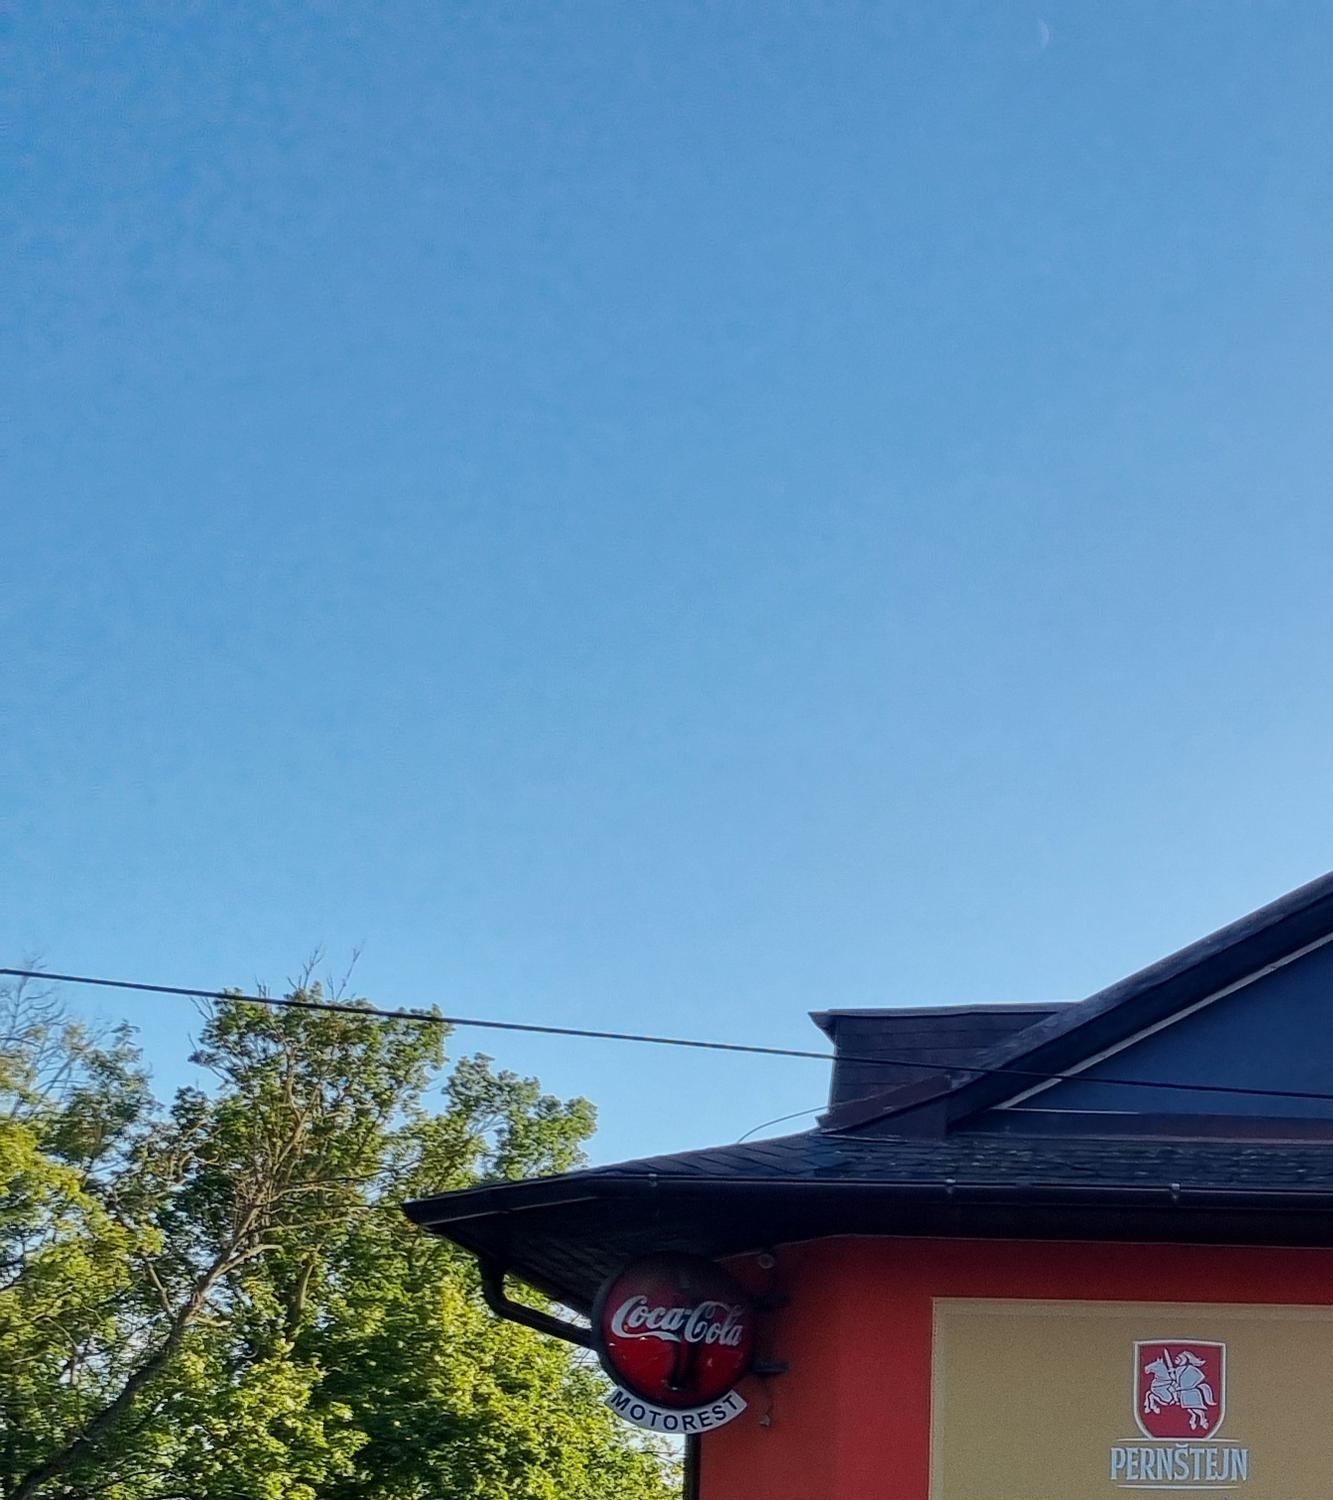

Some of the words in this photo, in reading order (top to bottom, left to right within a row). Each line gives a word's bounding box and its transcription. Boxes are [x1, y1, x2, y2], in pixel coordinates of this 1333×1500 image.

[611, 1295, 744, 1347] Coca-Cola
[610, 1390, 740, 1431] MOTOREST
[1110, 1443, 1249, 1481] PERNŠTEJN
